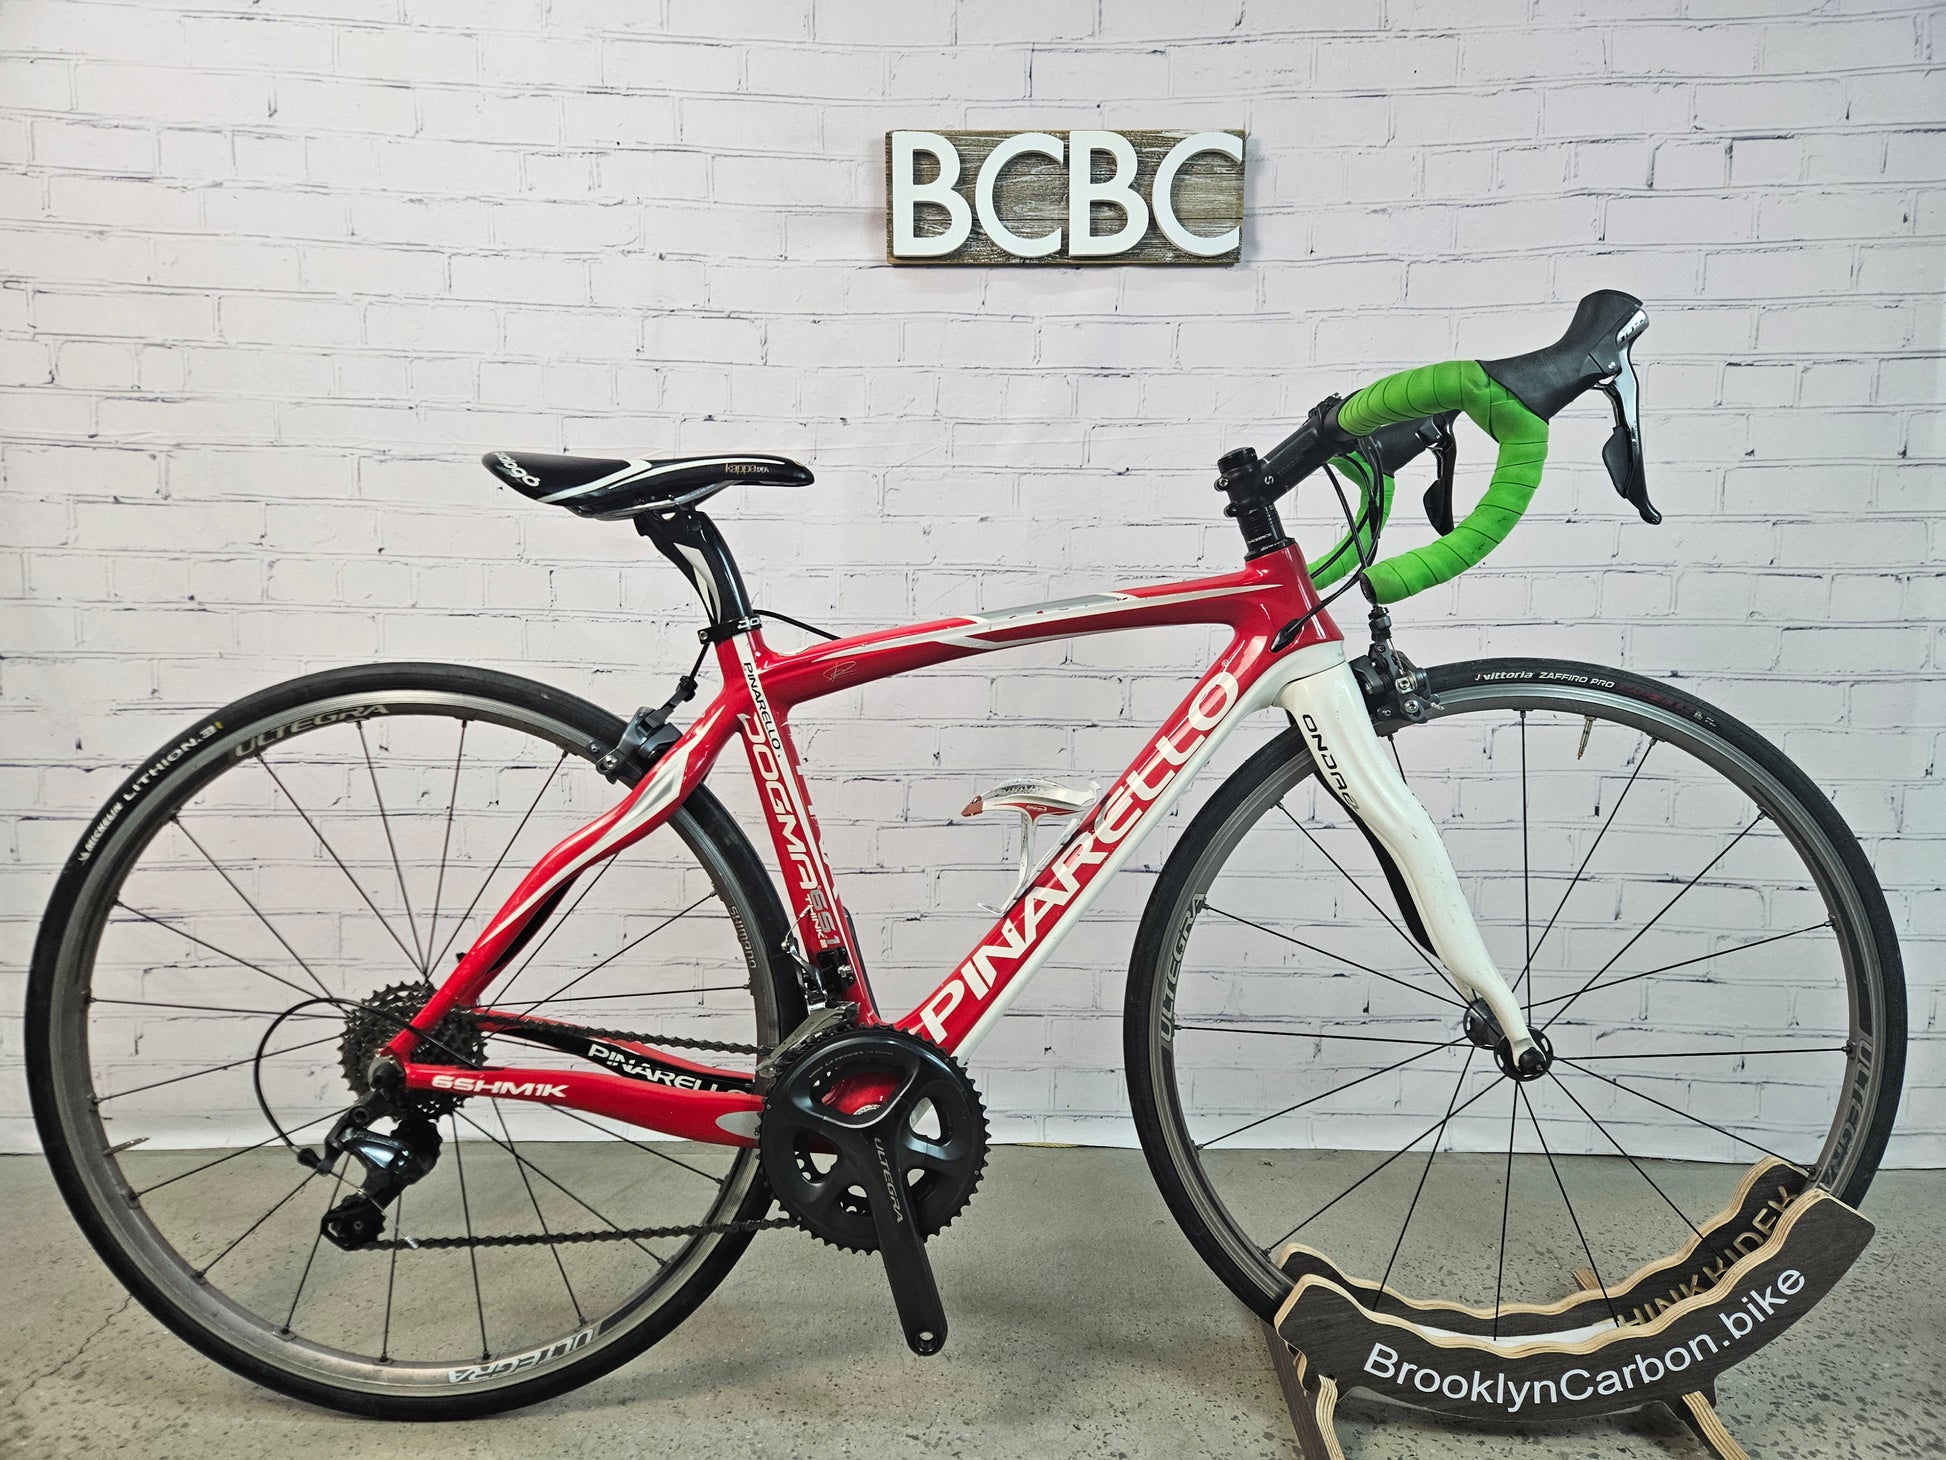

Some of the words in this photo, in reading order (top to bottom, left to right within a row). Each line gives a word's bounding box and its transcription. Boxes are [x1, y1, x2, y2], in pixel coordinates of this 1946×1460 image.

[891, 130, 1244, 259] BCBC
[725, 463, 757, 476] kappa
[743, 661, 782, 751] PINARELLO
[1482, 670, 1534, 681] vittoria
[1538, 671, 1589, 684] ZAFFIRO
[1589, 677, 1615, 689] PRO
[234, 704, 390, 758] ULTEGRA
[84, 801, 124, 852] MICHELIN
[737, 711, 818, 890] DOGMA
[918, 671, 1239, 1045] PINARELLO
[1160, 892, 1207, 1042] ULTEGRA
[587, 1043, 748, 1095] PINAREL
[873, 1136, 904, 1224] ULTEGRA
[448, 1328, 594, 1384] ULTEGRA
[1362, 1267, 1806, 1413] BrooklynCarbon.bike
